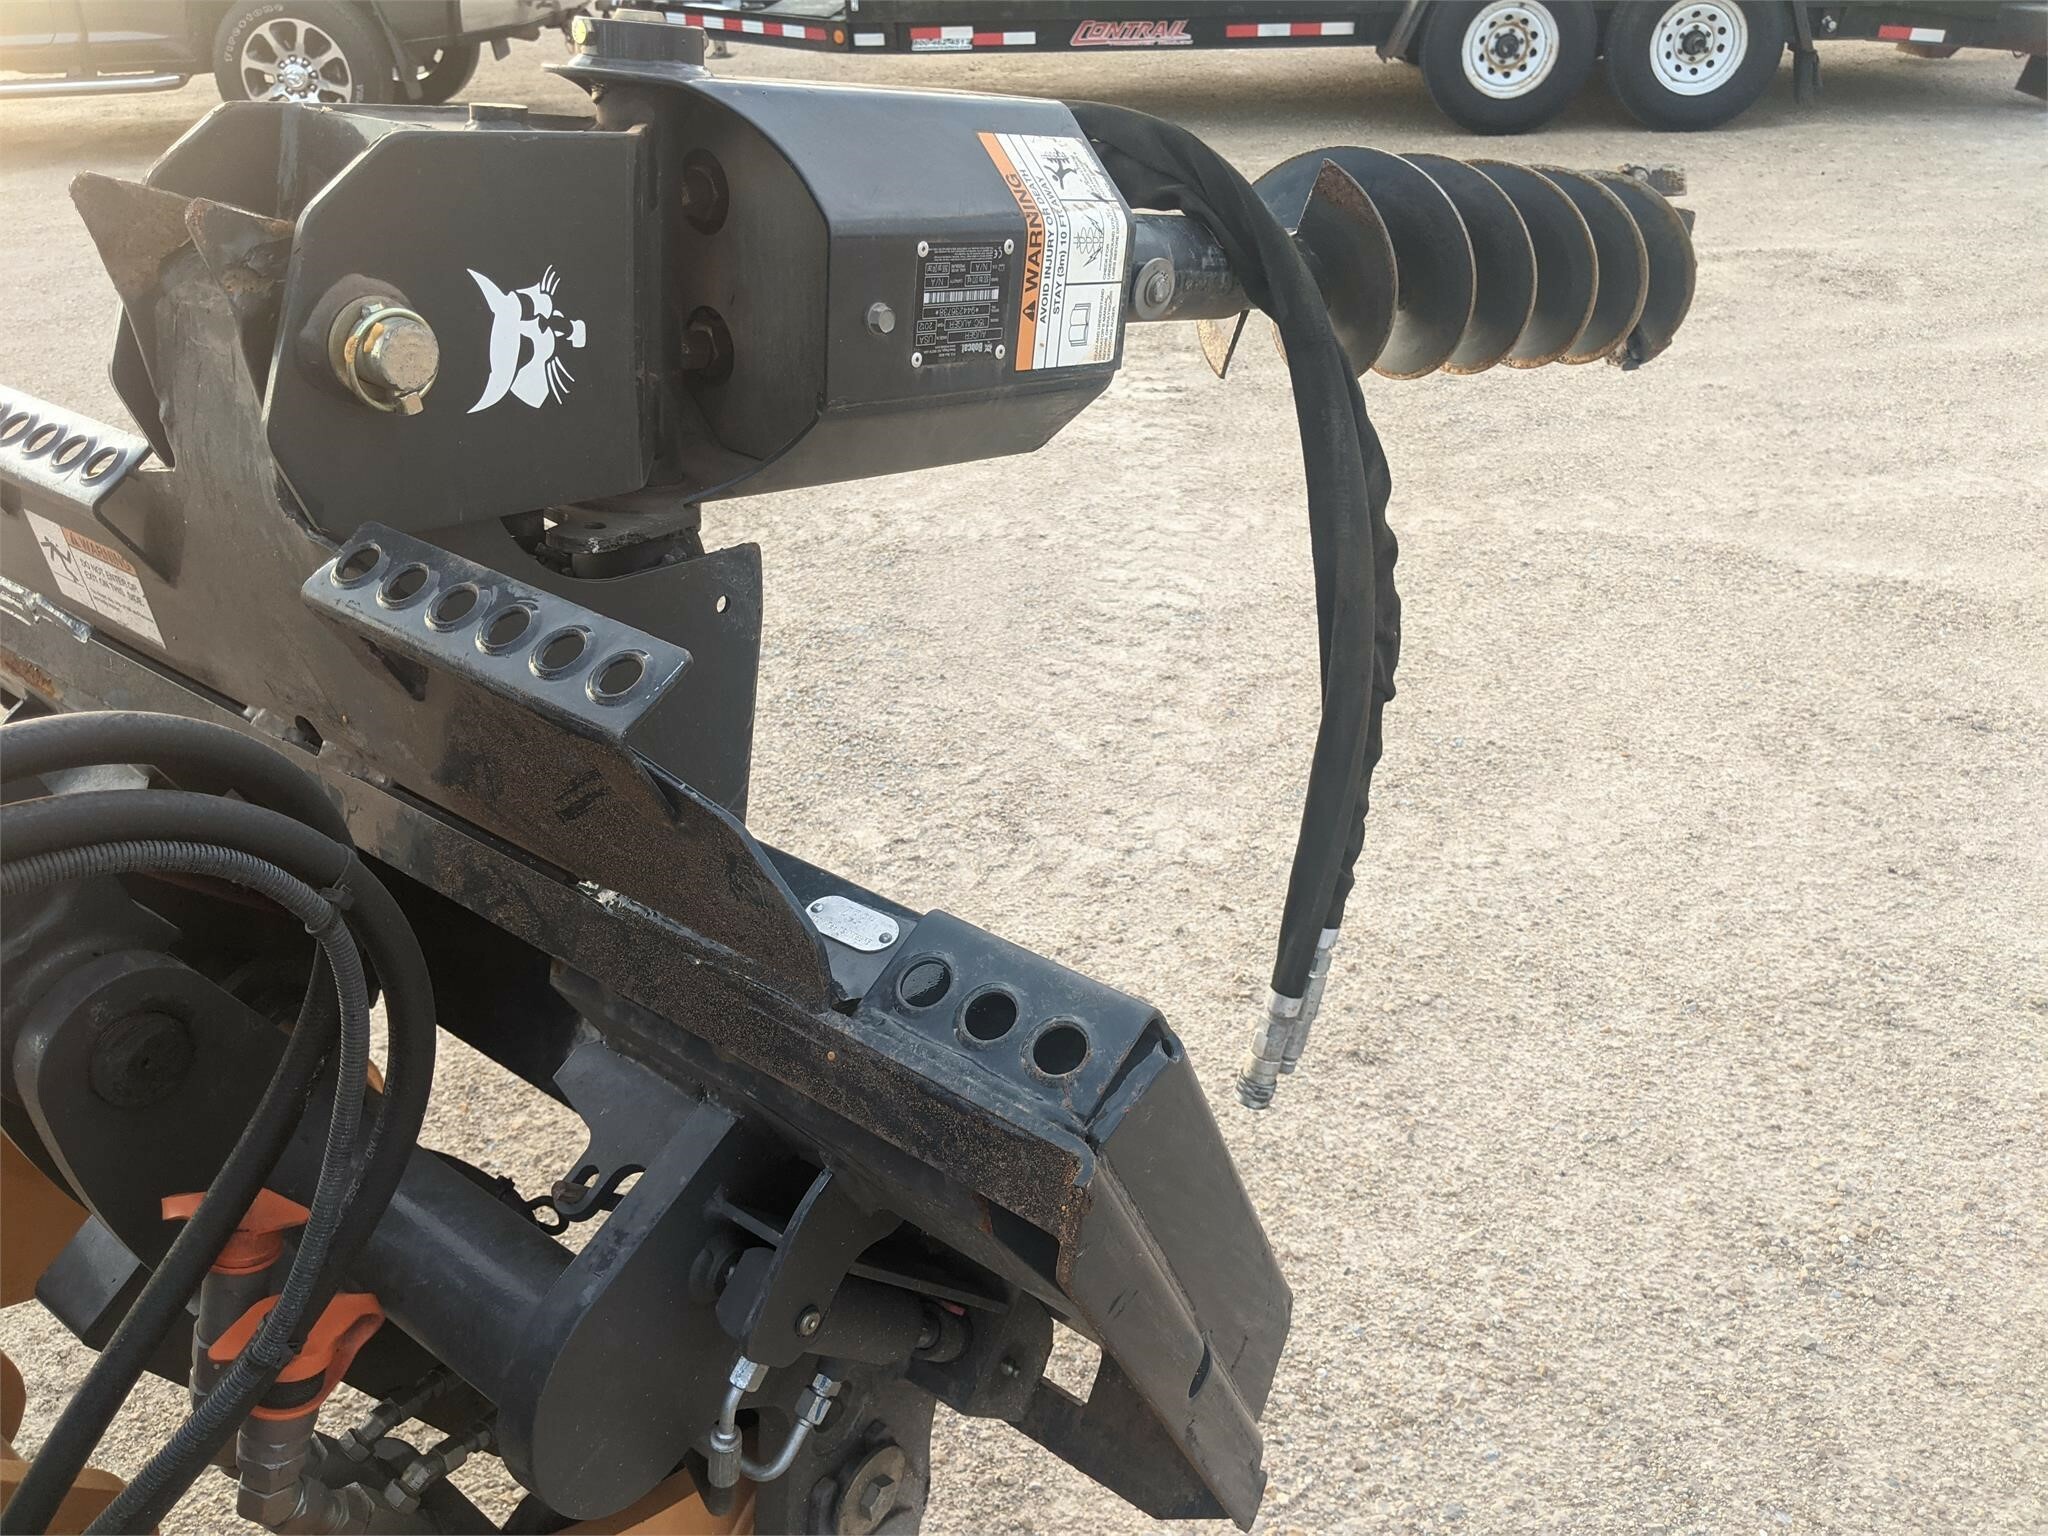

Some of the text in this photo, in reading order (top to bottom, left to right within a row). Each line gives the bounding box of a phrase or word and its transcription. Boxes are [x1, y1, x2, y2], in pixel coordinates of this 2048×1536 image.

[1070, 19, 1192, 45] CONTRAIL
[1037, 175, 1058, 208] AWAY
[1006, 173, 1043, 293] WARNING
[1060, 231, 1068, 247] 10
[1020, 169, 1055, 323] AVOID INJURY OR DEATH
[975, 264, 988, 272] N/A
[1057, 250, 1067, 278] (3m)
[931, 278, 944, 286] N/A
[1053, 281, 1063, 315] STAY
[949, 320, 972, 329] AUGER
[919, 335, 934, 343] USA
[962, 342, 983, 353] Bobcat
